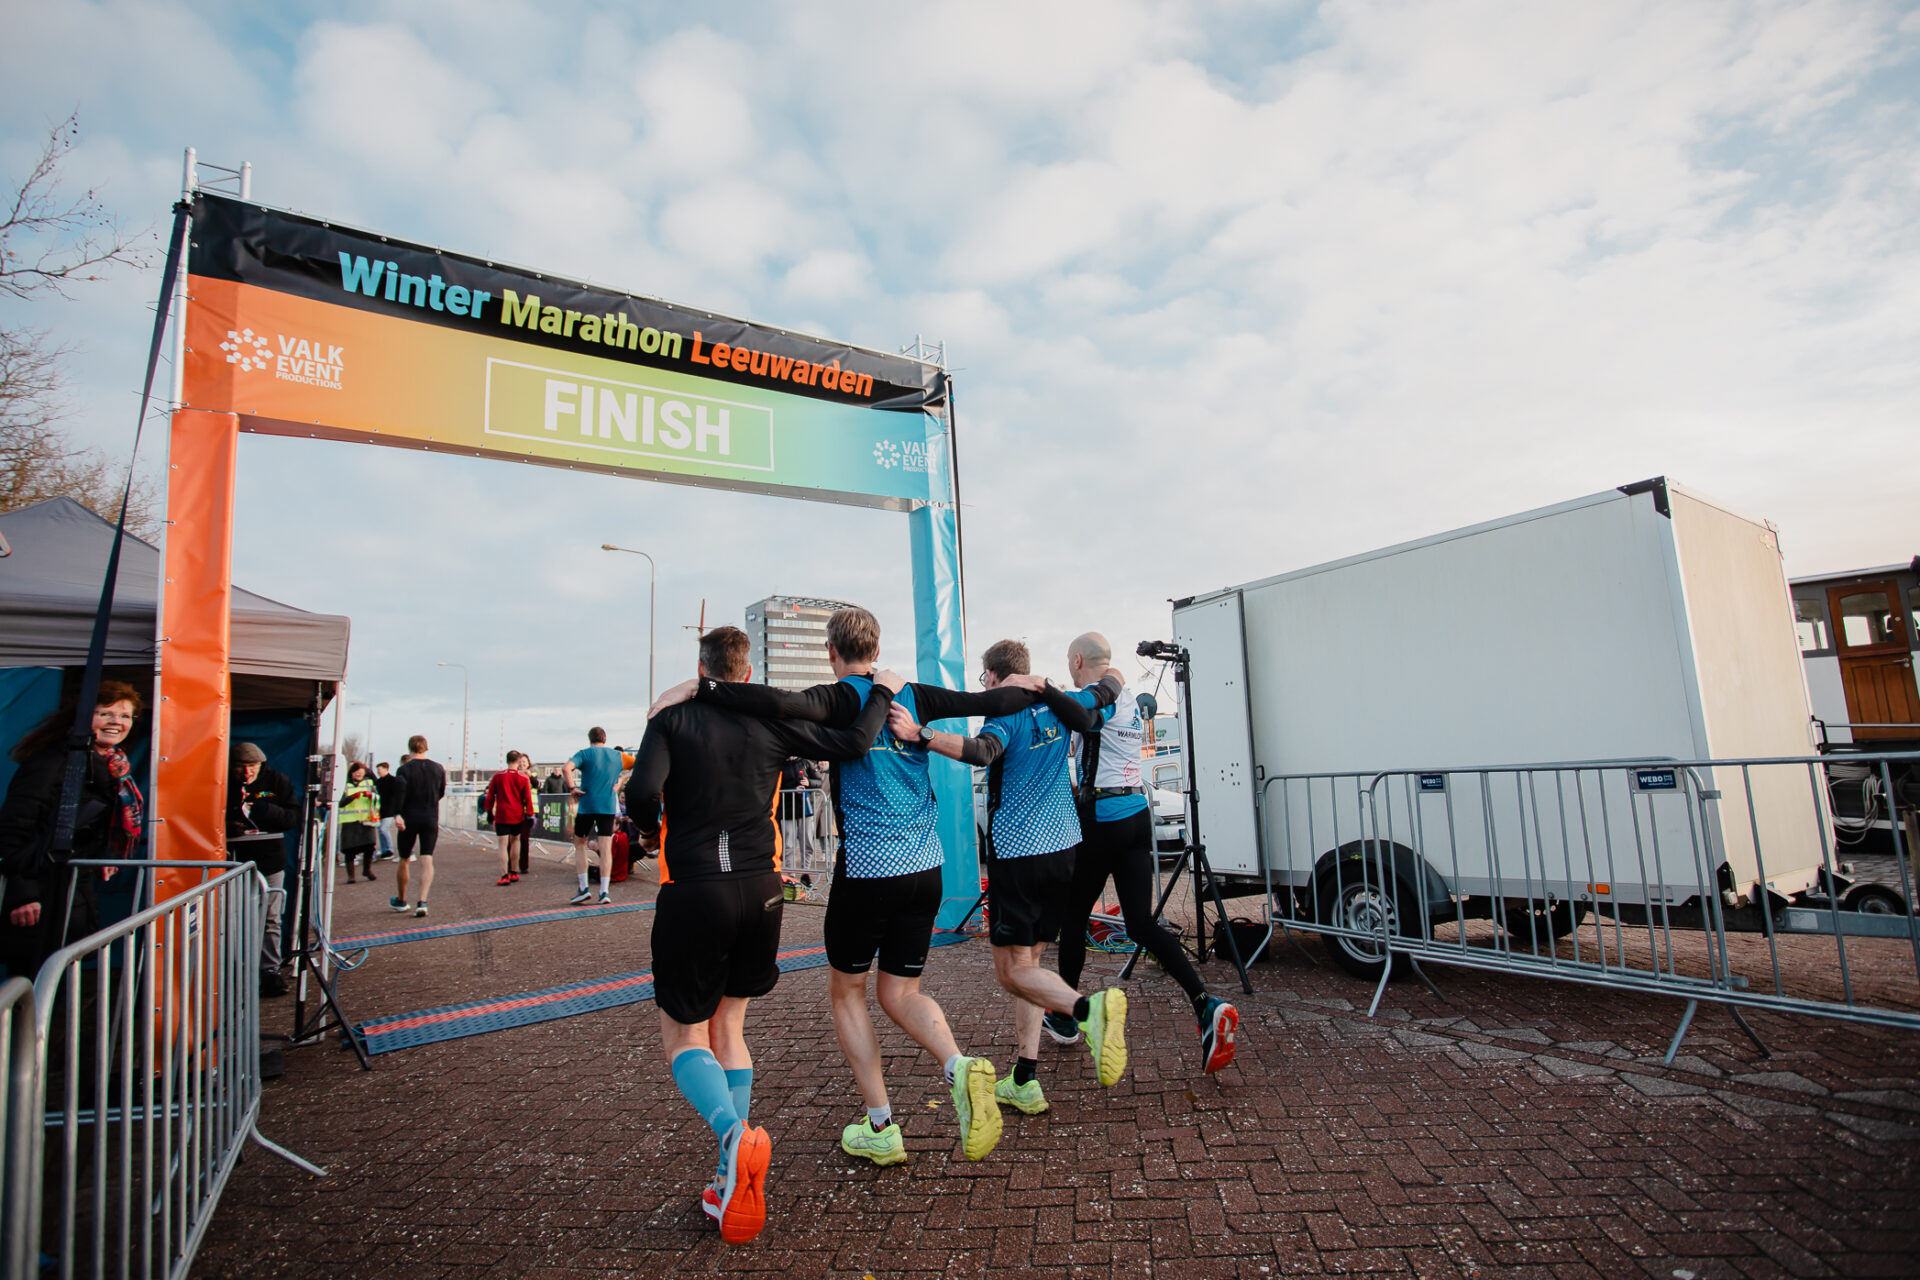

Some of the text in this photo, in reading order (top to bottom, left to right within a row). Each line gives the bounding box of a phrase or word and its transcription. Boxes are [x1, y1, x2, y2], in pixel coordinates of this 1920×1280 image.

[338, 251, 873, 397] Winter Marathon Leeuwarden
[278, 334, 344, 366] VALK
[275, 371, 343, 390] PRODUCTIONS
[277, 355, 344, 381] EVENT
[544, 379, 730, 455] FINISH
[902, 441, 936, 457] VALK
[1640, 775, 1663, 783] WEBO
